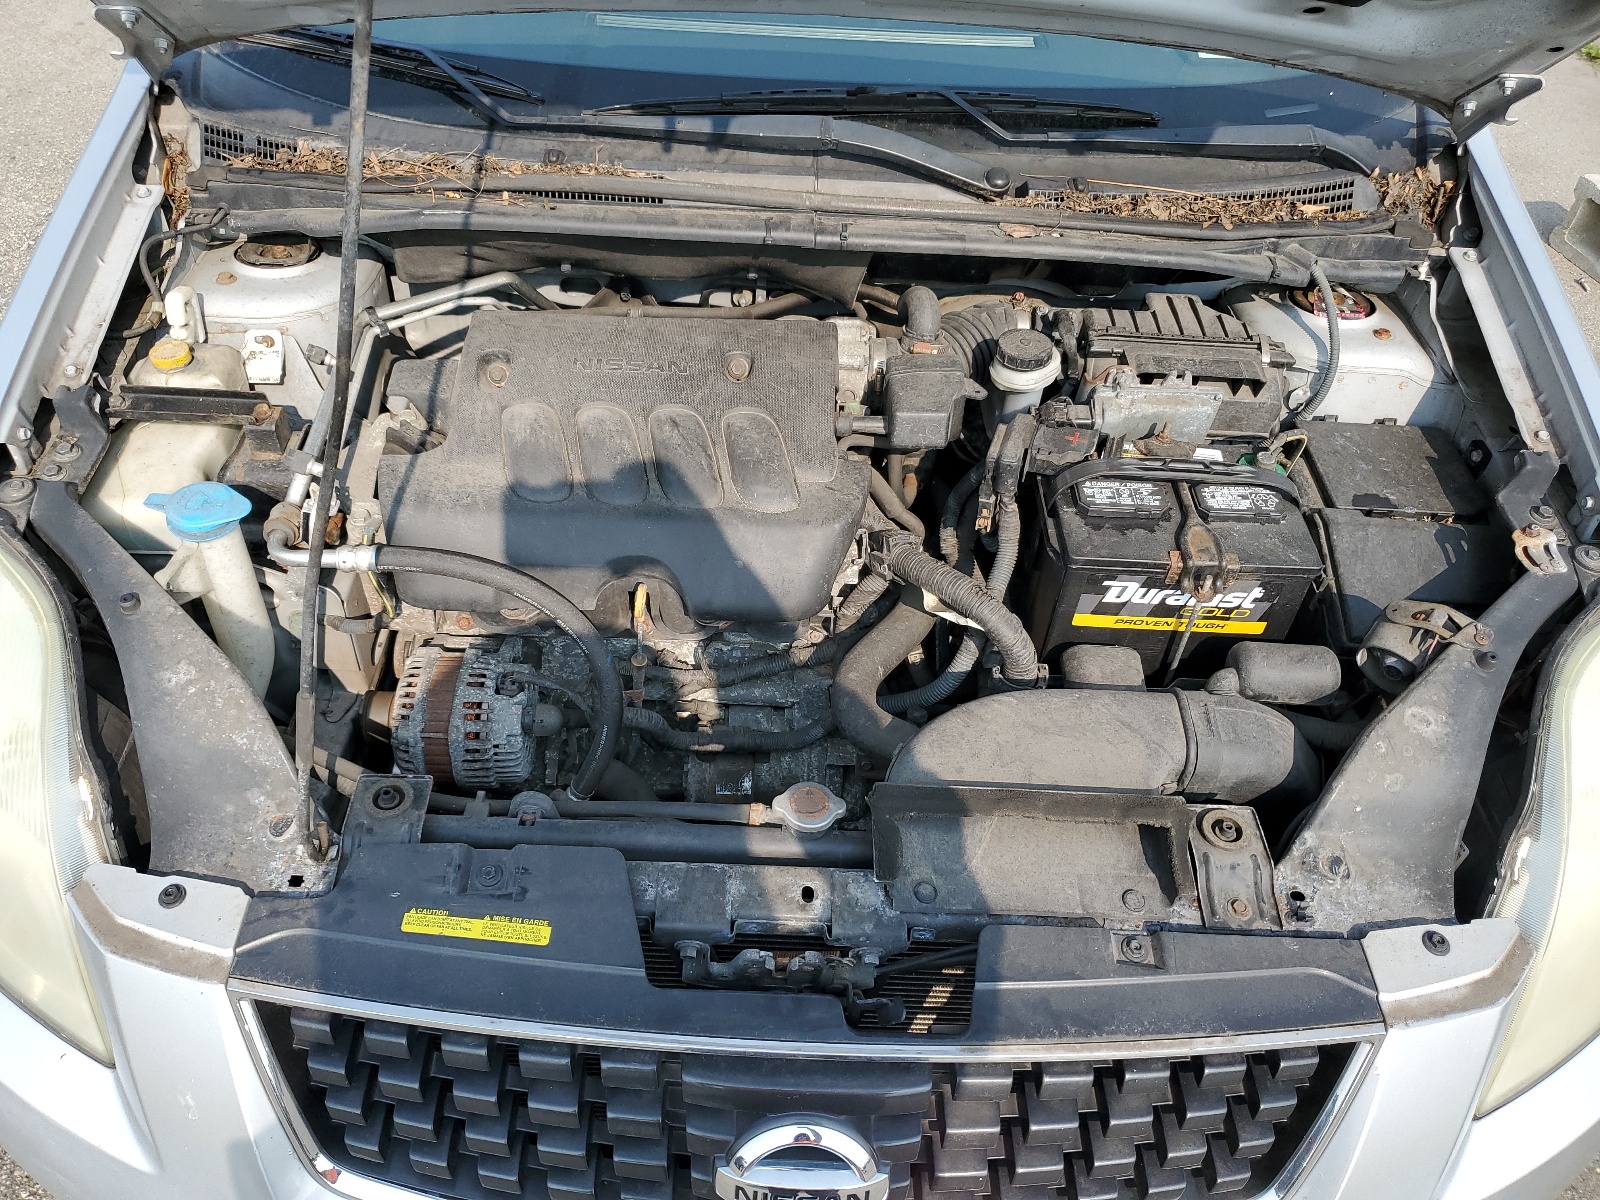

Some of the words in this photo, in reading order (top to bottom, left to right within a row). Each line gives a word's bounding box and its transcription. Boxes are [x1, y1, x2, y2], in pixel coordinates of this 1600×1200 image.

[571, 358, 689, 375] NISSAN
[1180, 606, 1251, 618] GOLD
[1113, 618, 1174, 627] PROVEN
[417, 908, 449, 916] CAUTION
[492, 915, 511, 923] MISE
[511, 916, 523, 924] EN
[523, 918, 550, 927] GARDE
[734, 1184, 871, 1200] NIN
